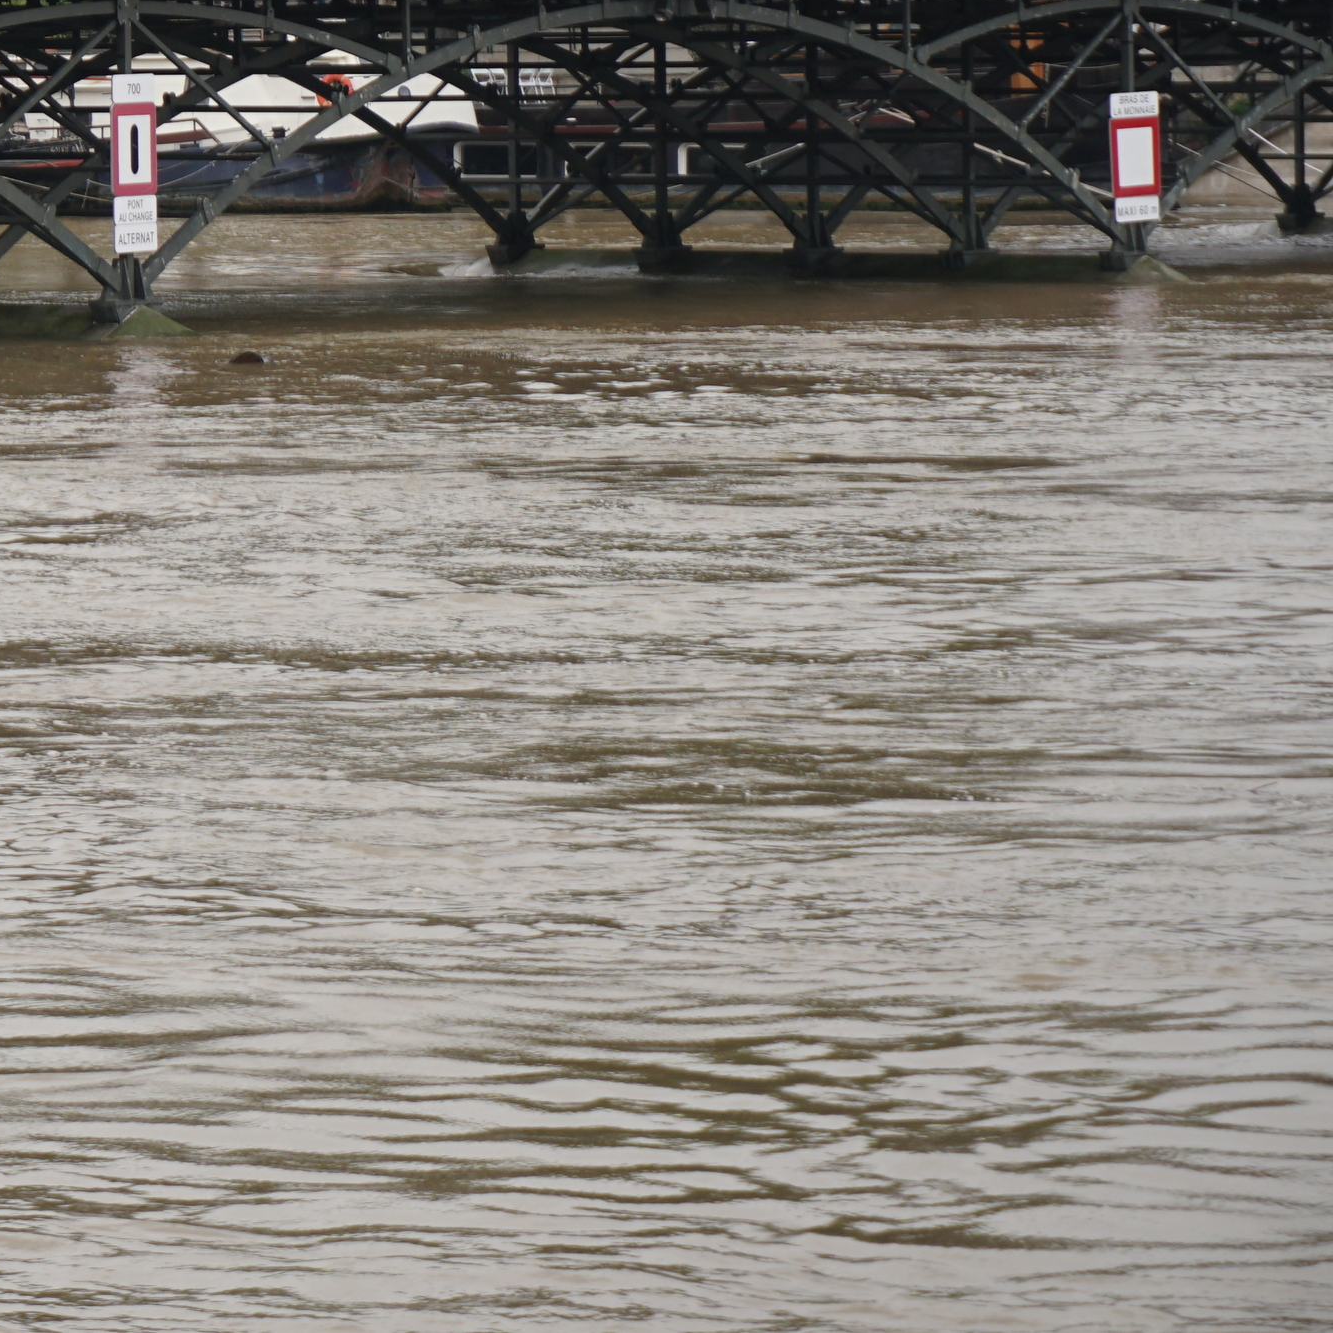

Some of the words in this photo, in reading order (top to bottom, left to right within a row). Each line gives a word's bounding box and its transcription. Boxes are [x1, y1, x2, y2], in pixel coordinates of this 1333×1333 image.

[127, 82, 141, 95] 700
[1119, 94, 1138, 104] BRAS
[1140, 93, 1149, 103] DE
[1113, 107, 1122, 116] LA
[1124, 105, 1156, 115] MONNAIE
[127, 199, 144, 209] PONT
[1117, 206, 1137, 216] MAXI
[1139, 204, 1149, 215] 60
[118, 212, 127, 222] AU
[128, 211, 153, 222] CHANGE
[118, 231, 154, 245] ALTERNAT
